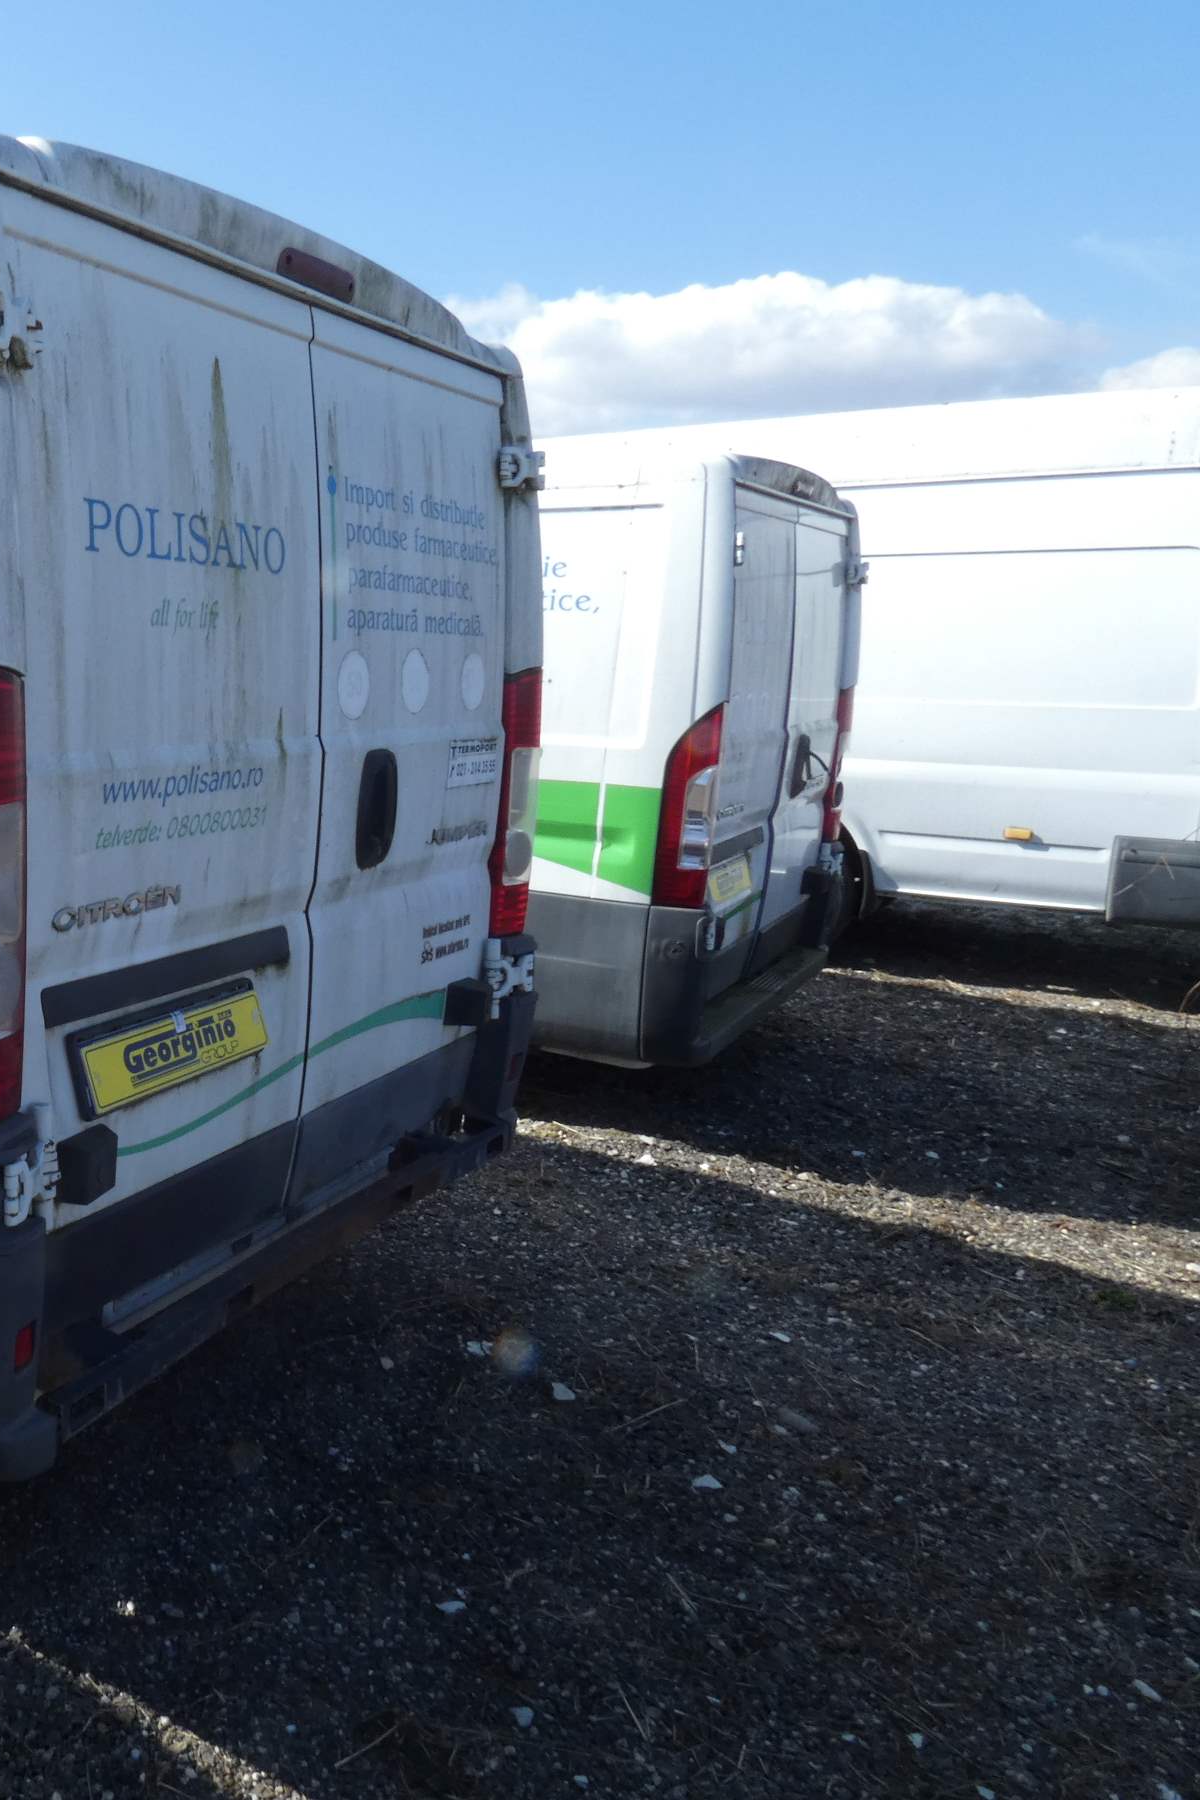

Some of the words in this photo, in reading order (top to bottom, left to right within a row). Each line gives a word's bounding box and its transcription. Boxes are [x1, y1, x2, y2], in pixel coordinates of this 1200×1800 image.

[344, 476, 397, 513] Import
[83, 497, 286, 575] POLISANO
[346, 517, 408, 551] produse
[348, 564, 473, 602] parafarmaceutice,
[151, 597, 170, 628] all
[174, 598, 195, 636] for
[103, 765, 264, 808] www.polisano.ro
[96, 820, 163, 850] telverde:
[166, 804, 267, 841] 0800800031
[123, 1019, 236, 1075] Georginio
[200, 1040, 240, 1066] GROUP
